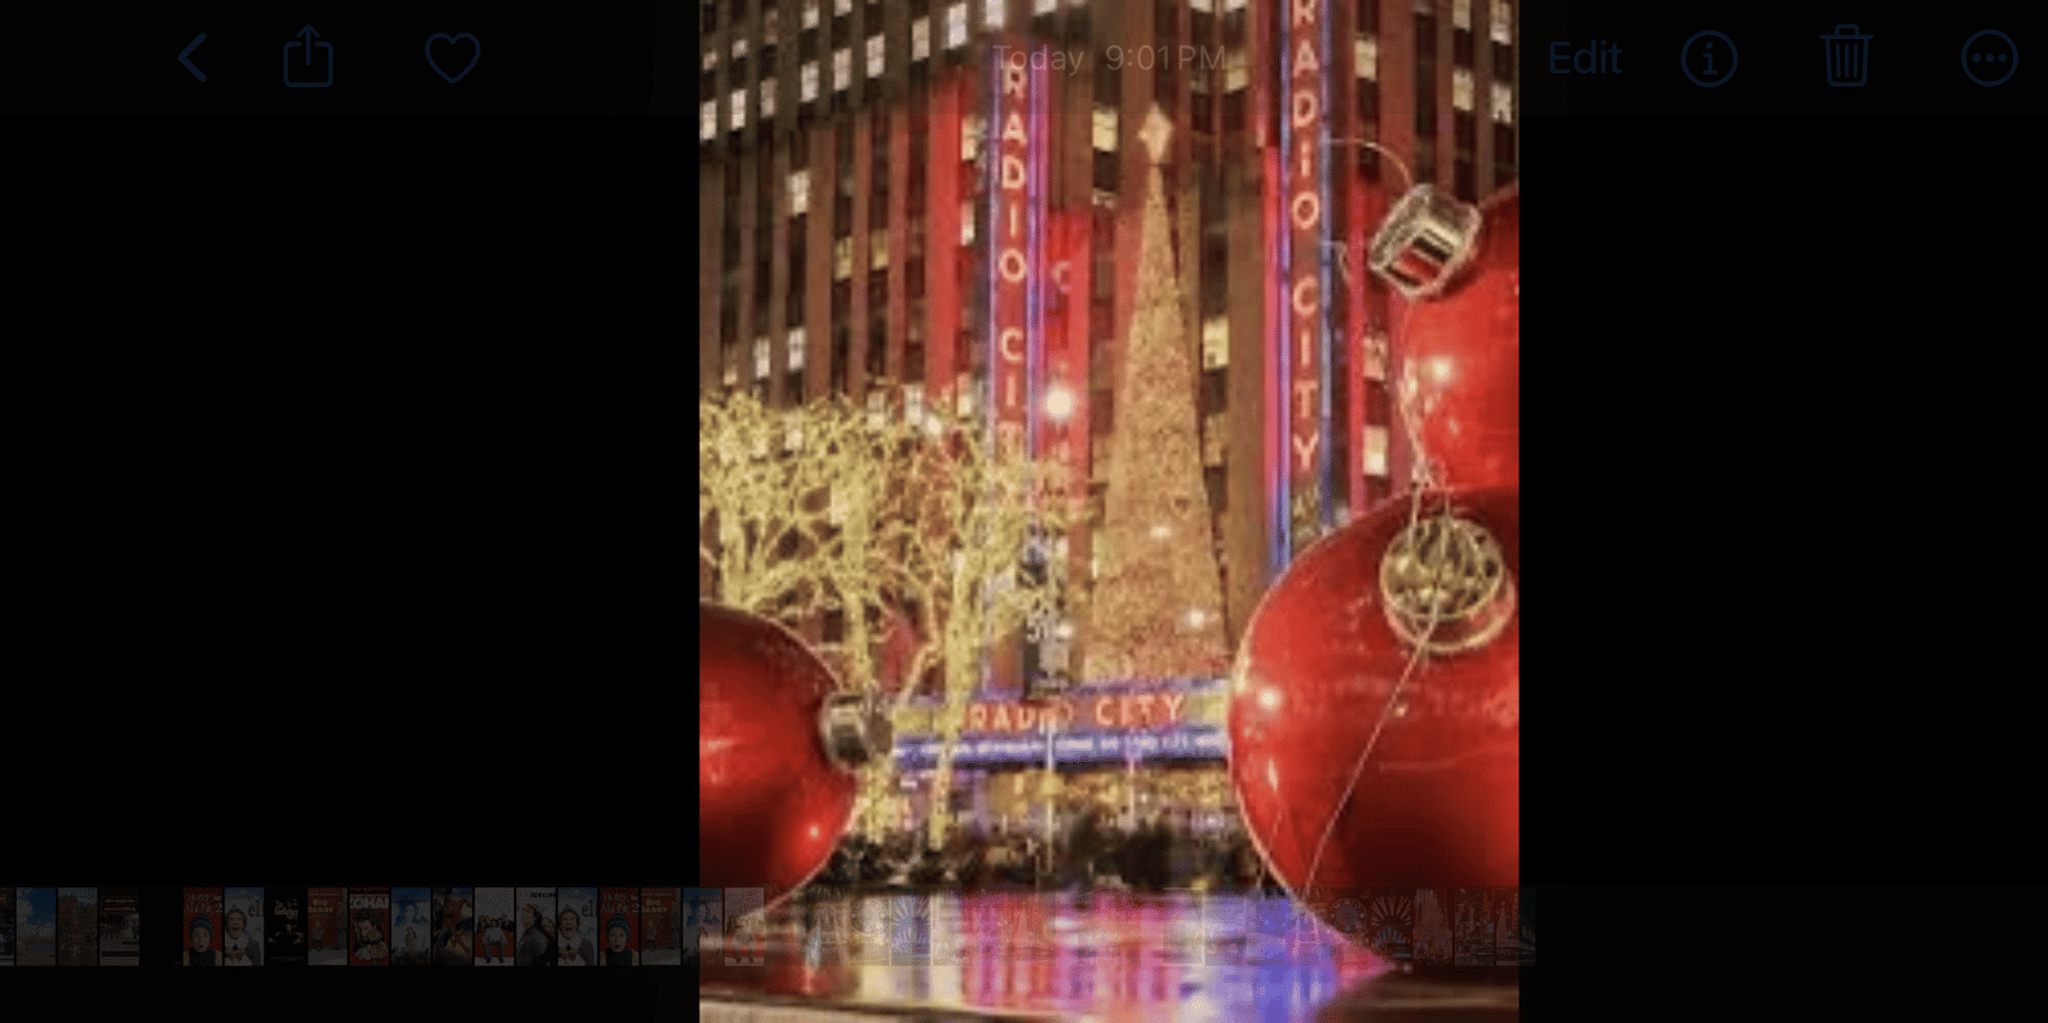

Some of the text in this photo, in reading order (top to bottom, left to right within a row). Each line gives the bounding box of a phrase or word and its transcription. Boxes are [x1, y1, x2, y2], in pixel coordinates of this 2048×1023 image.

[998, 60, 1028, 283] RADIO
[1291, 0, 1320, 471] RADIO CITY
[1095, 693, 1185, 728] CITY
